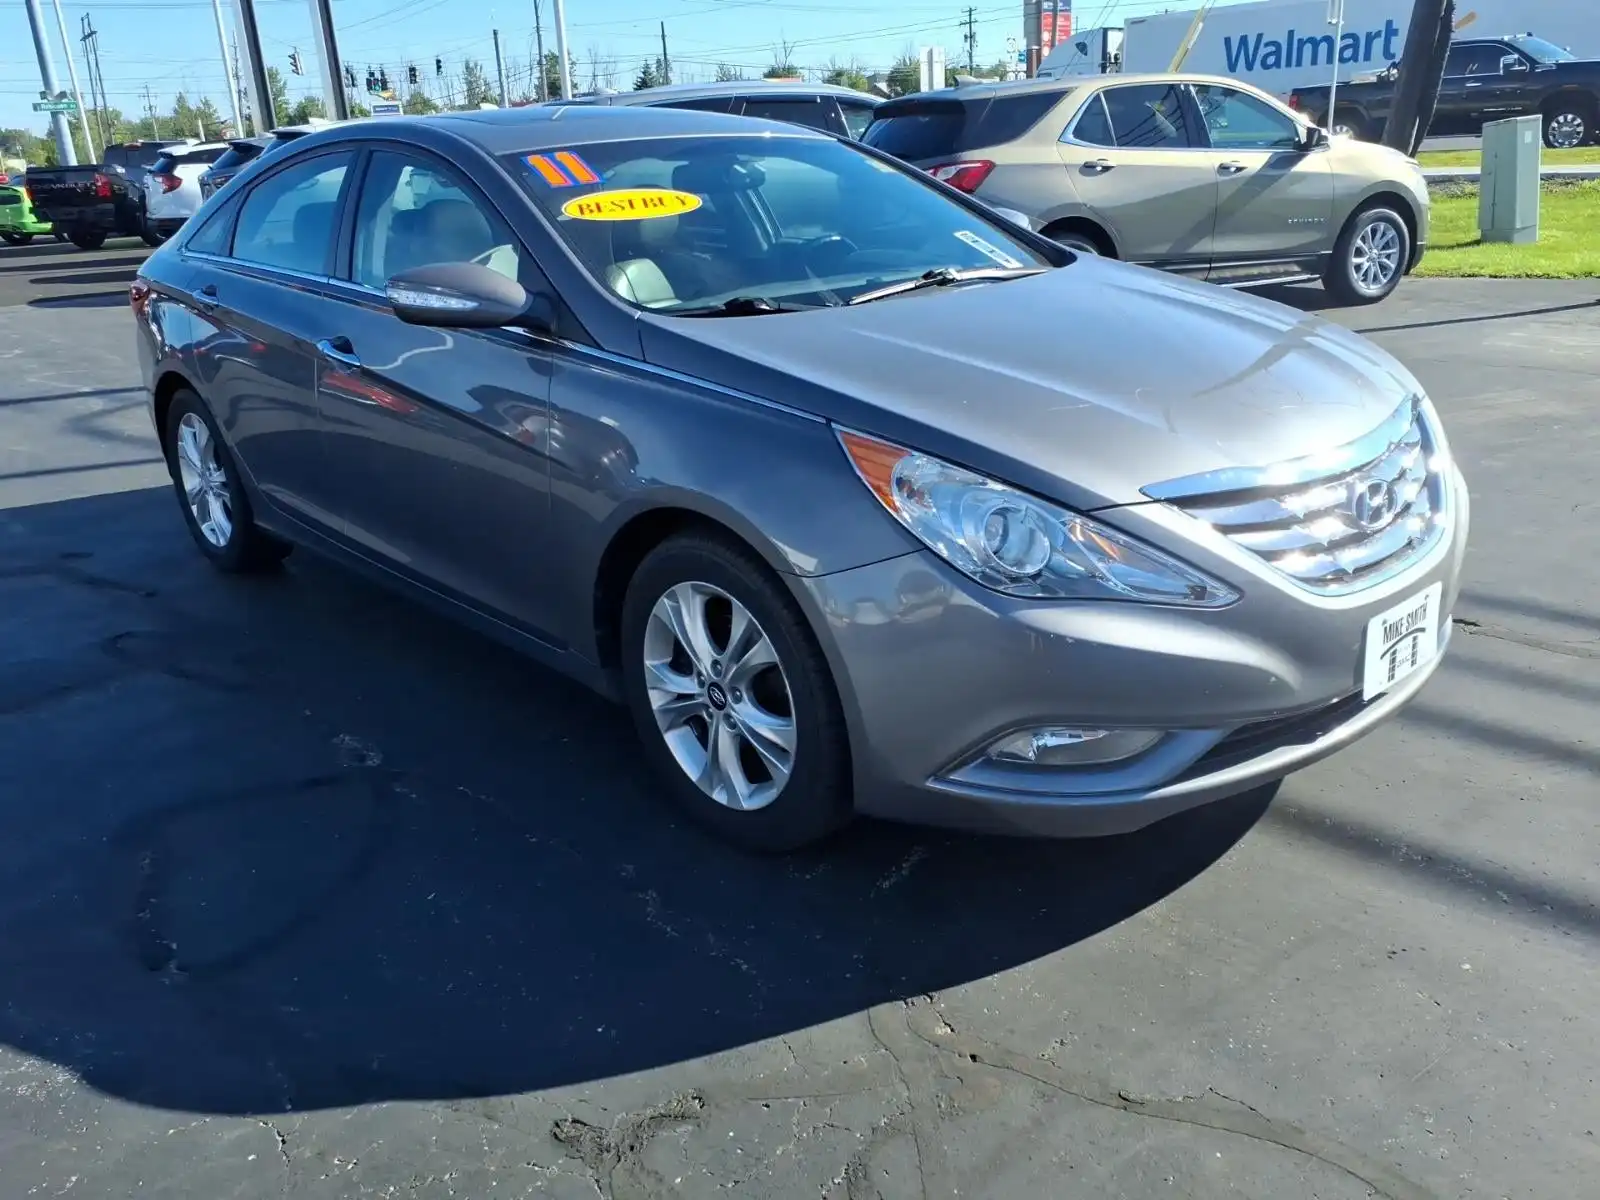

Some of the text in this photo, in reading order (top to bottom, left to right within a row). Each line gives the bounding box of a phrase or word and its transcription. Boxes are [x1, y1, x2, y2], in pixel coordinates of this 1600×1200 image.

[1224, 19, 1399, 73] Walmart
[527, 151, 601, 188] 11
[577, 195, 687, 216] BEST BUY
[1383, 602, 1428, 644] MIKE SMITH
